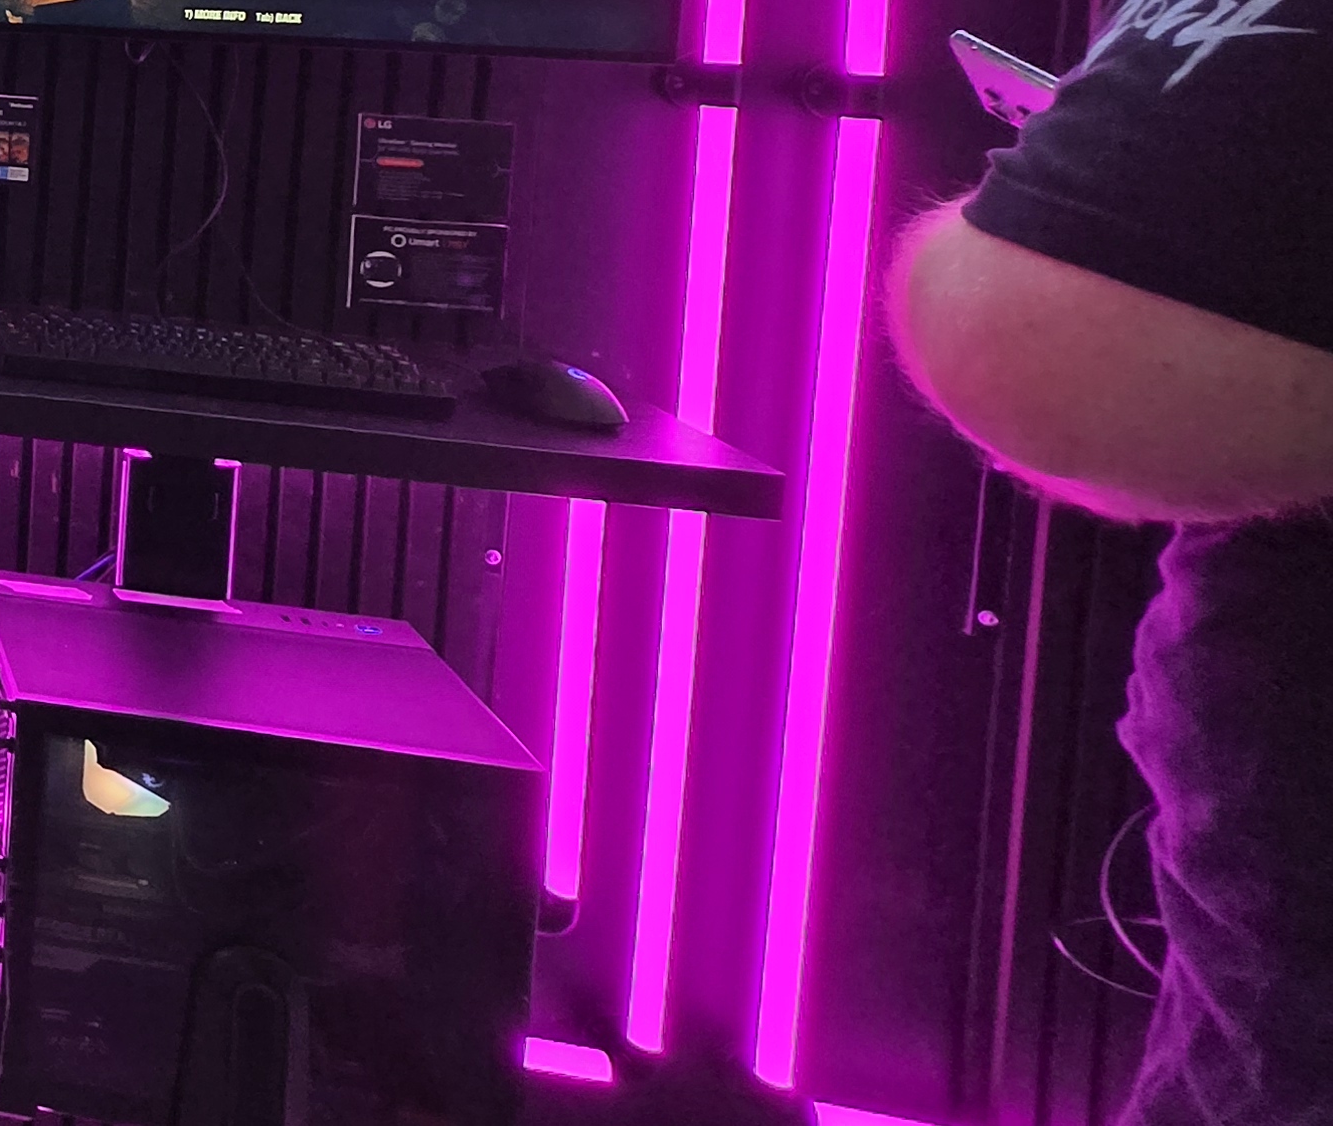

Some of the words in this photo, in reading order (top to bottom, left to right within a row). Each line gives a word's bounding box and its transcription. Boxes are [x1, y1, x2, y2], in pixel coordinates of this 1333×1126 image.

[194, 10, 222, 21] MORE
[222, 10, 247, 21] INFO
[275, 13, 302, 24] BACK
[378, 120, 393, 129] LG
